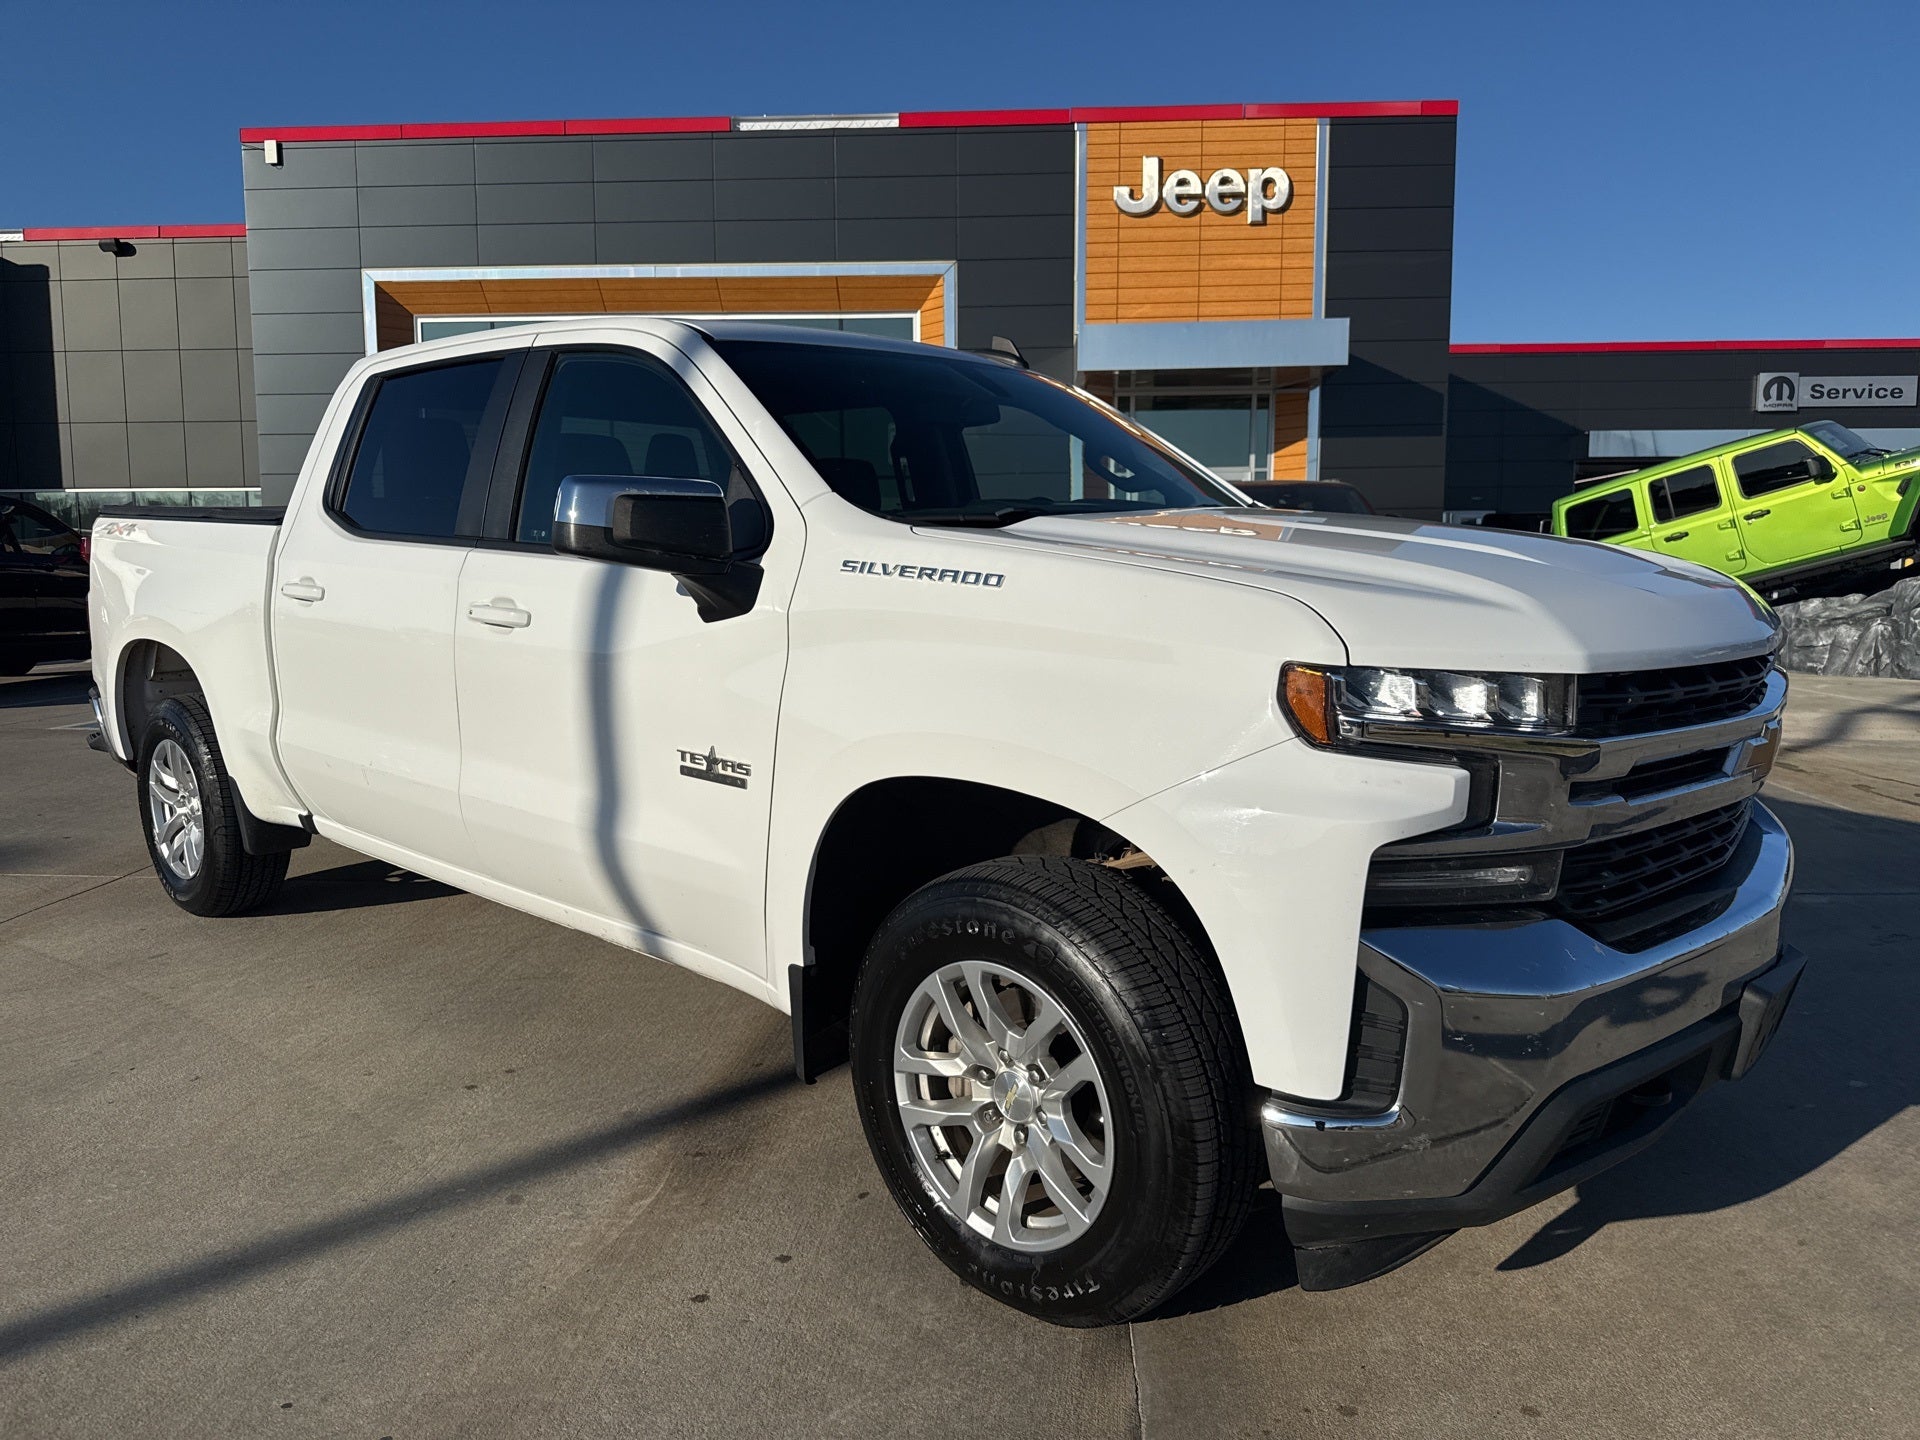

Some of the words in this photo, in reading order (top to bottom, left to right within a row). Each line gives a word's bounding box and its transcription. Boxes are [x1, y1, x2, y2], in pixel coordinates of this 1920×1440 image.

[1113, 155, 1292, 225] Jeep
[1809, 383, 1904, 400] Service
[1864, 512, 1888, 524] Jeep
[840, 559, 1006, 588] SILVERADO
[676, 746, 751, 776] TEXAS
[897, 916, 1016, 958] restone
